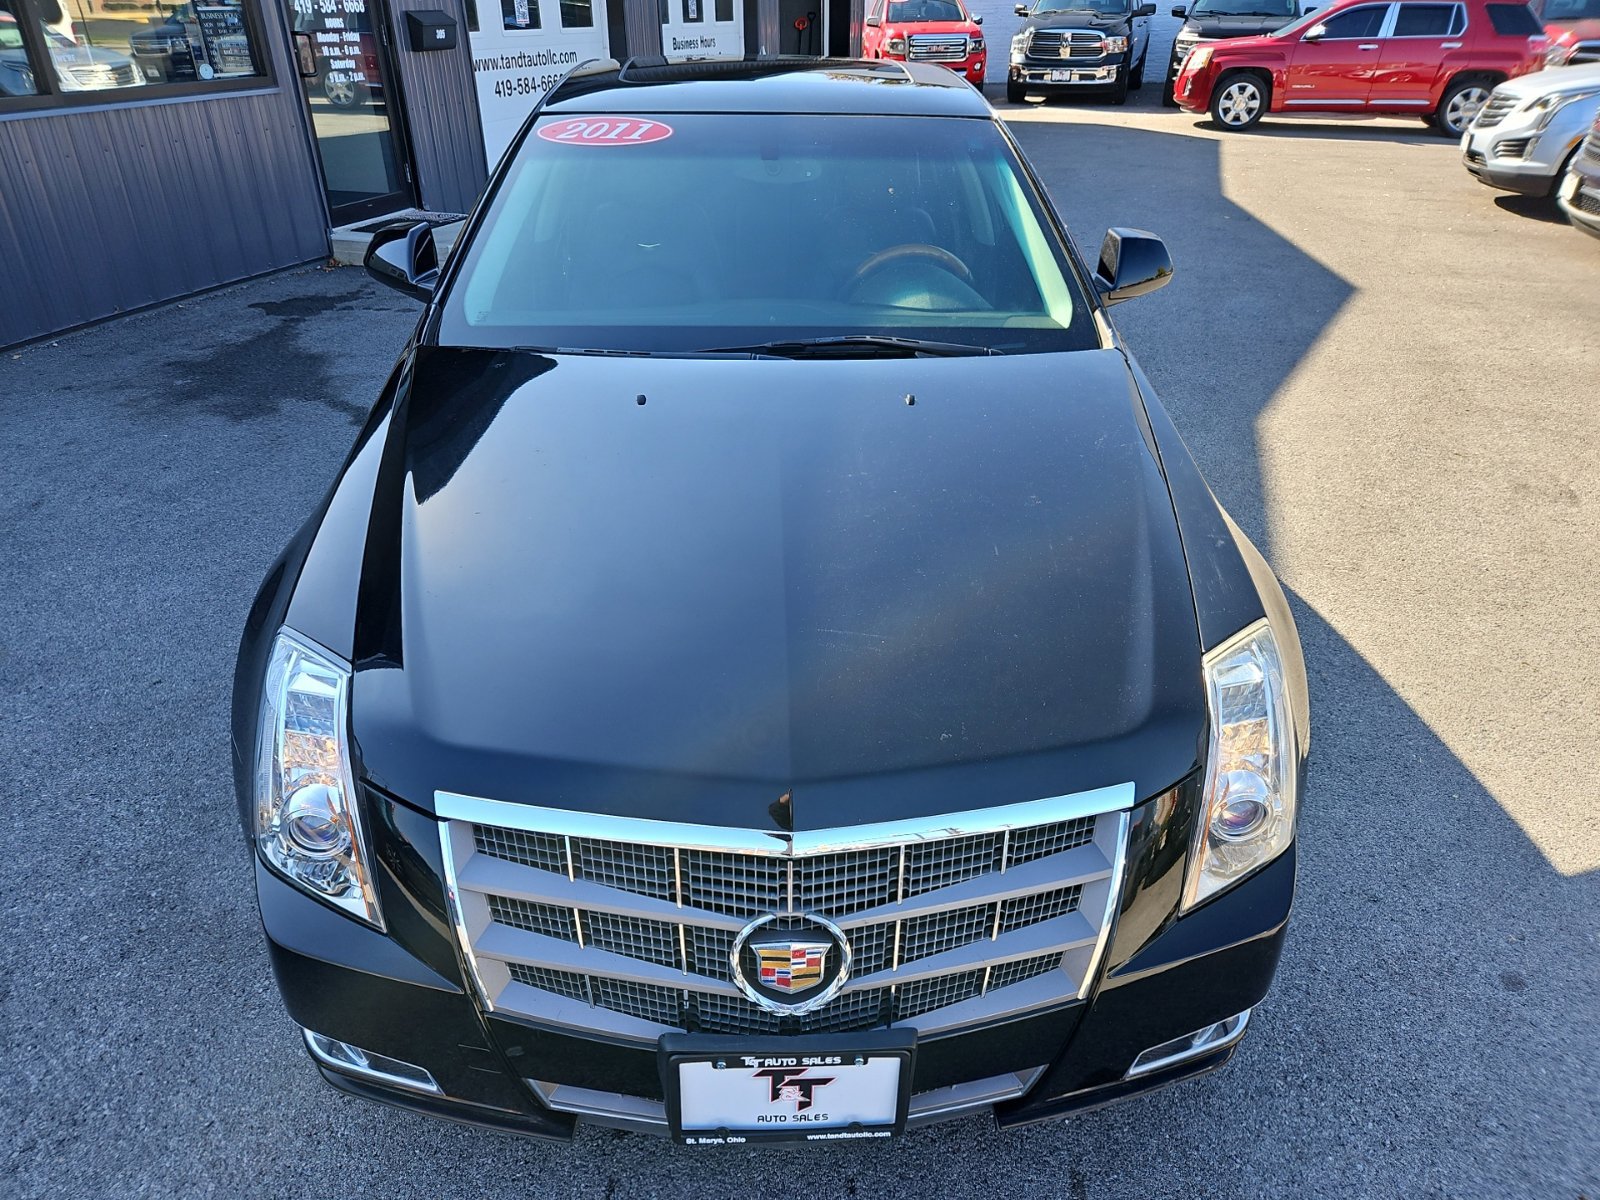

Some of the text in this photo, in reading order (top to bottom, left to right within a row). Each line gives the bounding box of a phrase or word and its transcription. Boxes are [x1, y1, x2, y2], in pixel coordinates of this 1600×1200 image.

[294, 0, 313, 13] 419
[319, 0, 337, 13] 584
[325, 17, 344, 28] HOURS
[316, 32, 340, 43] Monday
[343, 31, 360, 42] Friday
[672, 35, 716, 50] Business Hours
[330, 58, 356, 70] Saturday
[473, 49, 578, 72] www.tandtautollc.com
[556, 122, 653, 140] 2011
[765, 1057, 796, 1067] AUTO
[802, 1056, 842, 1065] SALES
[757, 1113, 829, 1123] AUTO SALES
[699, 1137, 725, 1145] Marys,
[807, 1131, 891, 1140] www.tandtautollc.com
